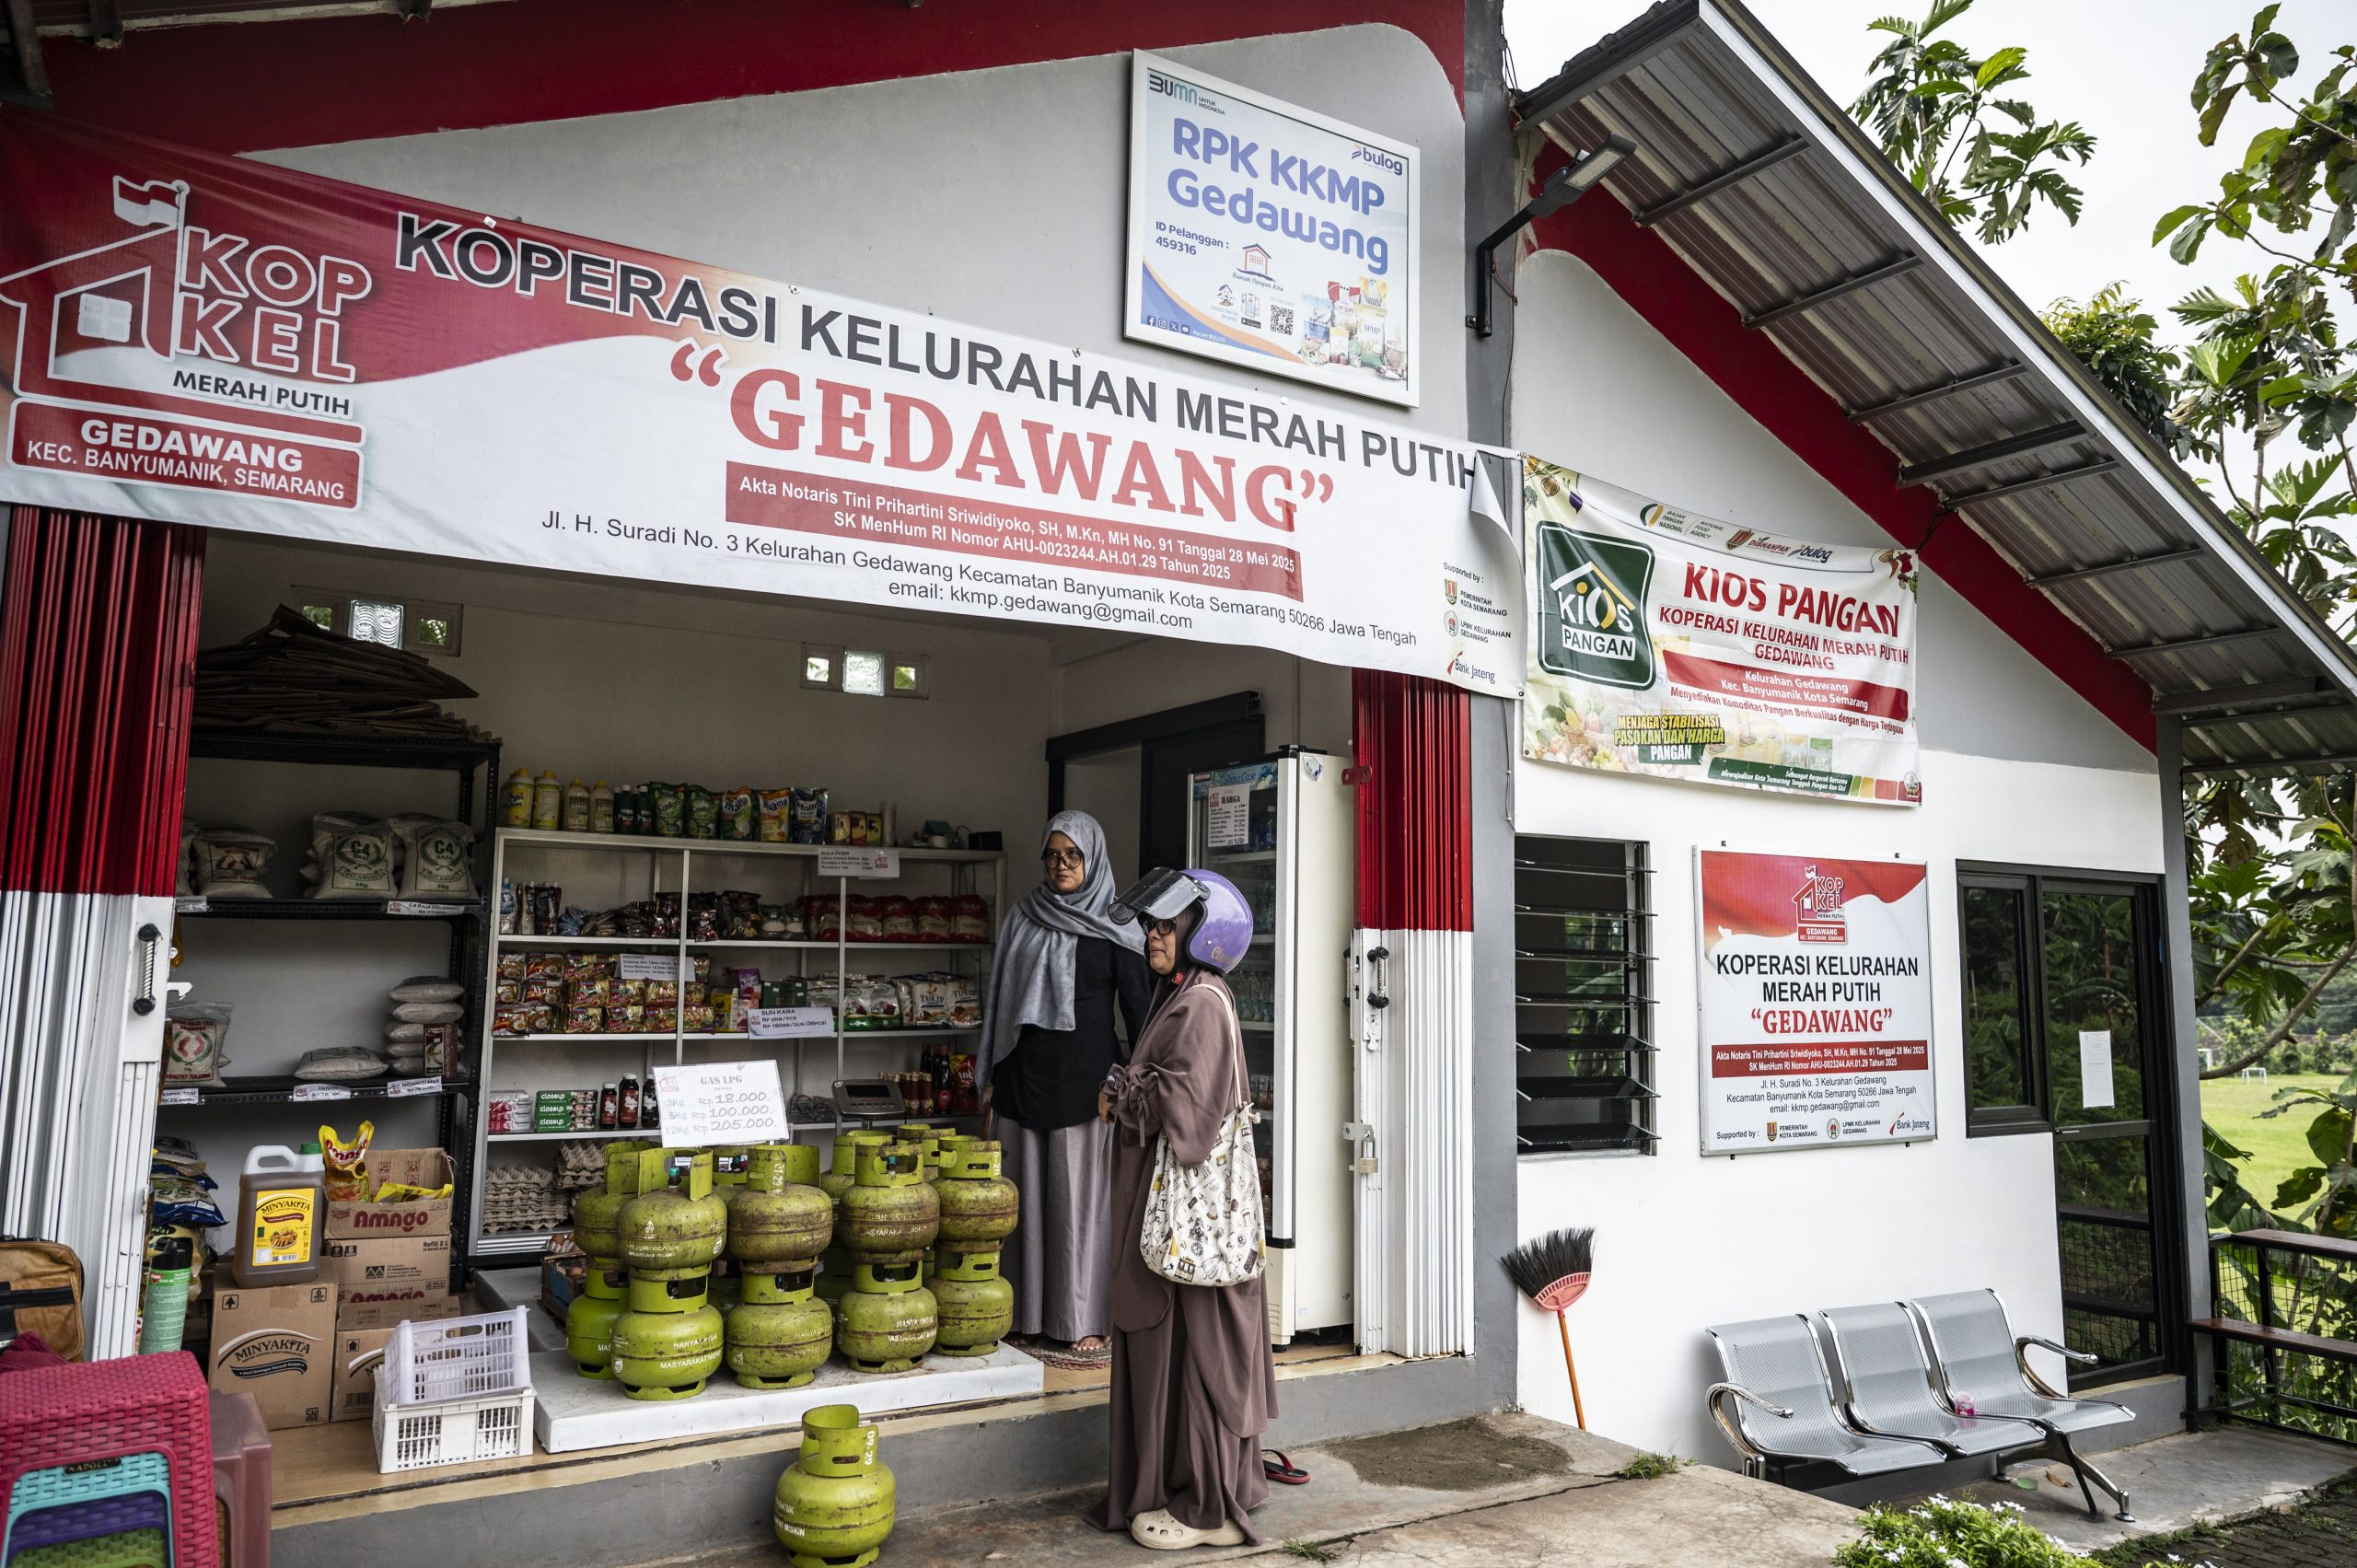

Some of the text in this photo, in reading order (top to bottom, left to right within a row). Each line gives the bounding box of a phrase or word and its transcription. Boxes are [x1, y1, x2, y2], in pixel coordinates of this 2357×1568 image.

[1198, 102, 1225, 116] INDONESIA
[1199, 96, 1216, 107] UNTUK
[1173, 117, 1385, 215] RPK KKMP
[1364, 147, 1402, 176] bulog
[1167, 168, 1387, 275] Gedawang
[1155, 221, 1224, 249] ID Pelanggan
[1155, 236, 1197, 255] 459316
[180, 226, 372, 316] KOP
[1232, 273, 1283, 292] Rumah Pangan Kita
[176, 292, 355, 382] KEL
[397, 214, 777, 343] KOPERASI
[801, 304, 1156, 423] KELURAHAN
[1177, 388, 1346, 461] MERAH
[1209, 333, 1225, 343] BULOG
[173, 370, 350, 415] MERAH PUTIH
[81, 420, 303, 471] GEDAWANG
[670, 342, 1334, 532] “GEDAWANG”
[28, 440, 345, 500] KEC. BANYUMANIK, SEMARANG
[739, 476, 1295, 573] Akta Notaris Tini Prihartini Sriwidiyoko, SH, M.Kn, MH No. 91 Tanggal 28 Mei 2025
[1662, 516, 1711, 533] PANGAN FOOD
[1666, 510, 1724, 531] BADAN NATIONAL
[1658, 522, 1713, 540] NASIONAL AGENCY
[834, 511, 1231, 580] SK MenHum RI Nomor AHU-0023244.AH.01.29 Tahun 2025
[1747, 540, 1833, 563] DISHANPAN bulog
[542, 510, 1416, 647] Jl. H. Suradi No. 3 Kelurahan Gedawang Kecamatan Banyumanik Kota Semarang 50266 Jawa Tengah
[1443, 563, 1480, 584] Supported by
[888, 582, 1192, 629] email: kkmp.gedawang@gmail.com
[1460, 590, 1492, 606] PEMERINTAH
[1460, 599, 1507, 616] KOTA SEMARANG
[1683, 562, 1899, 638] KIOS PANGAN
[1460, 630, 1488, 643] GEDAWANG
[1461, 621, 1511, 638] LPMK KELURAHAN
[1660, 606, 1909, 665] KOPERASI KELURAHAN MERAH PUTIH
[1563, 628, 1633, 656] PANGAN
[1755, 643, 1834, 670] GEDAWANG
[1456, 658, 1495, 684] Bank Jateng
[1745, 670, 1848, 694] Kelurahan Gedawang
[1721, 679, 1868, 711] Kec. Banyumanik Kota Semarang
[1670, 687, 1721, 706] Menyediakan
[1723, 699, 1762, 713] Komoditas
[1764, 704, 1793, 717] Pangan
[1795, 708, 1837, 722] Berkualitas
[1839, 712, 1860, 727] dengan
[1860, 717, 1879, 730] Harga
[1618, 714, 1720, 729] MENJAGA STABILISASI
[1614, 728, 1725, 746] PASOKAN DAN HARGA
[1650, 745, 1691, 761] PANGAN
[1222, 796, 1240, 805] HARGA
[351, 841, 370, 855] C4
[435, 840, 453, 854] C4
[1816, 877, 1844, 893] KOP
[1817, 894, 1842, 910] KEL
[1716, 954, 1918, 977] KOPERASI KELURAHAN
[921, 995, 945, 1004] TULIP
[952, 990, 977, 998] TULIP
[1763, 981, 1881, 1002] MERAH PUTIH
[1751, 1007, 1893, 1034] “GEDAWANG”
[701, 1075, 742, 1085] GAS LPG
[540, 1093, 565, 1101] closeup
[698, 1098, 713, 1108] Rp
[540, 1106, 563, 1114] closeup
[691, 1112, 706, 1122] Rp
[692, 1125, 708, 1135] Rp
[1897, 1120, 1930, 1132] Bank Jateng
[261, 1201, 310, 1214] MINYAKITA
[235, 1340, 310, 1362] MINYAKITA
[784, 1523, 806, 1537] MISKIN
